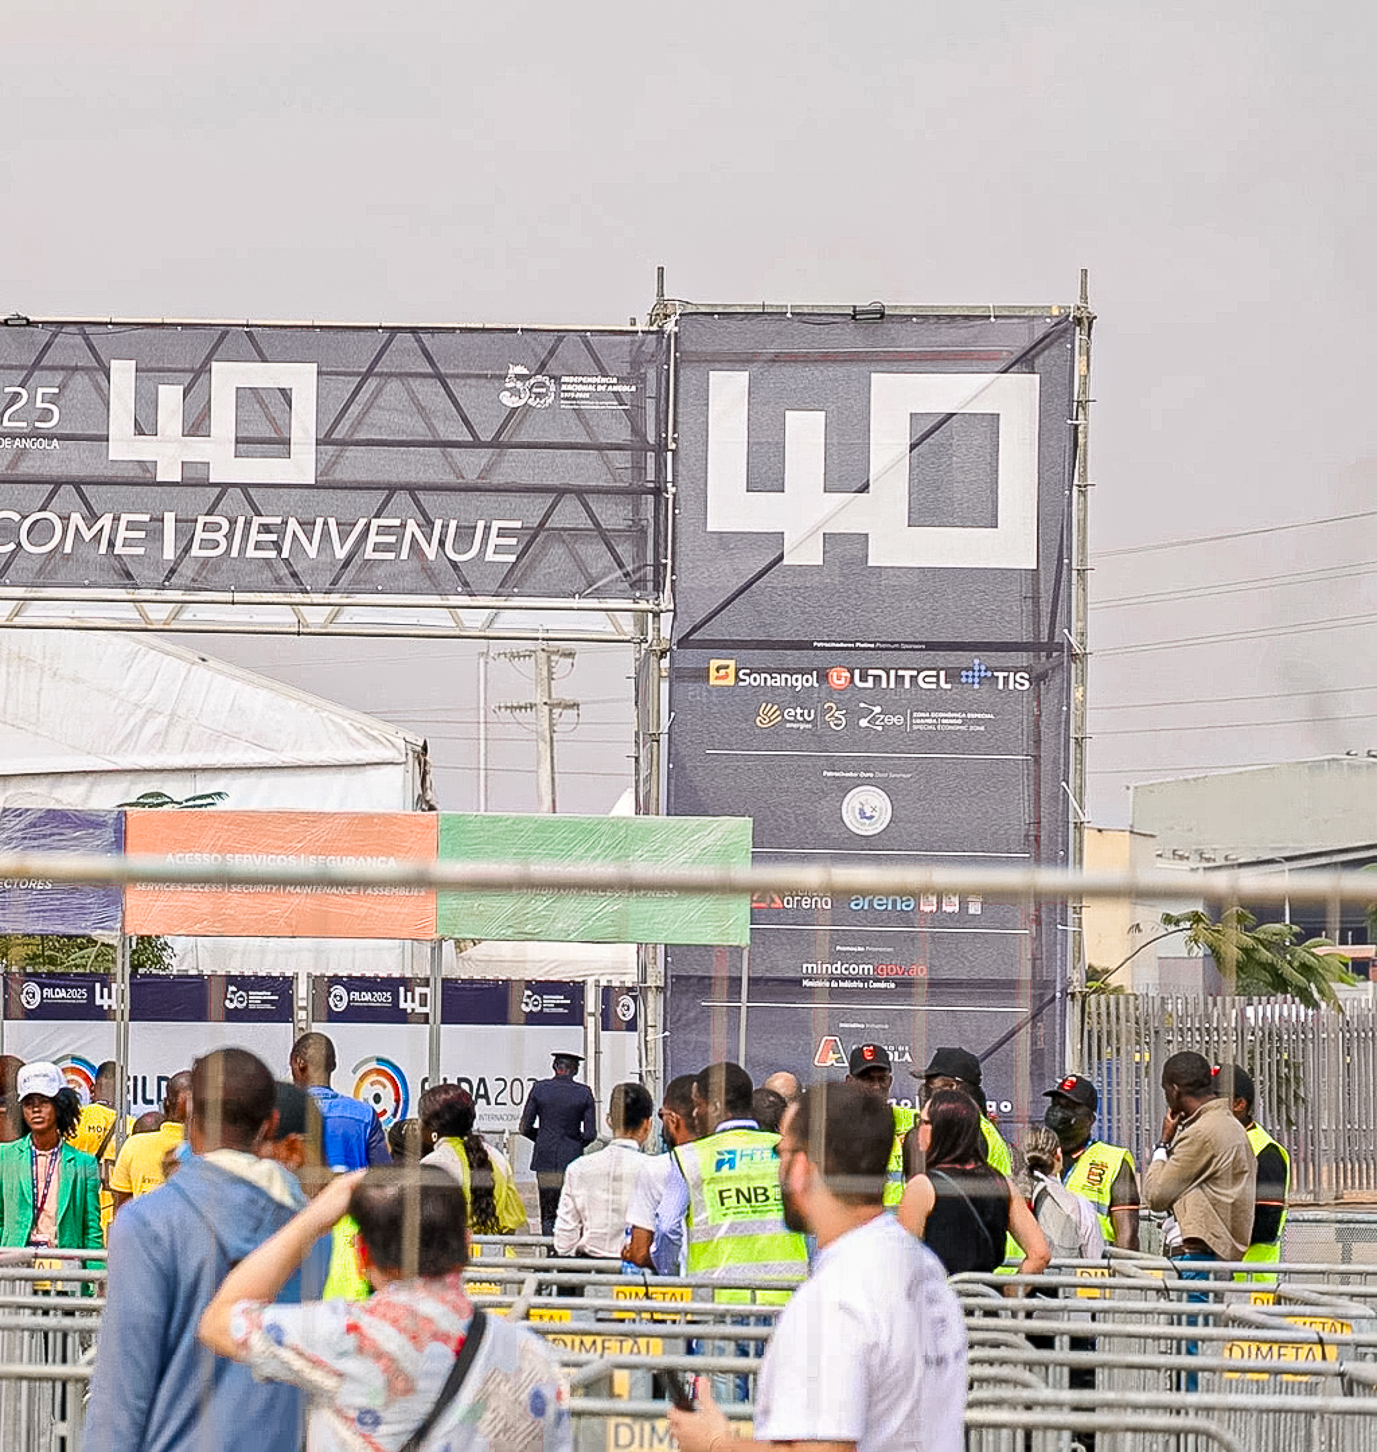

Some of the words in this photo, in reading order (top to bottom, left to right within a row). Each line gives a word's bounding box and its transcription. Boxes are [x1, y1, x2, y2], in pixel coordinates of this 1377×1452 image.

[109, 359, 318, 485] 40
[13, 438, 60, 450] ANGOLA
[706, 370, 1040, 569] 40
[189, 514, 524, 563] BIENVENUE
[737, 669, 819, 692] Sonangol
[854, 669, 952, 690] UNITEL
[994, 671, 1030, 691] TIS
[784, 706, 815, 721] etu
[166, 853, 221, 866] ACESSO
[135, 882, 182, 892] SERVICES
[230, 883, 278, 893] SECURITY
[783, 896, 832, 909] arena
[849, 893, 915, 911] arena
[802, 960, 927, 978] mindcom.gov.ao
